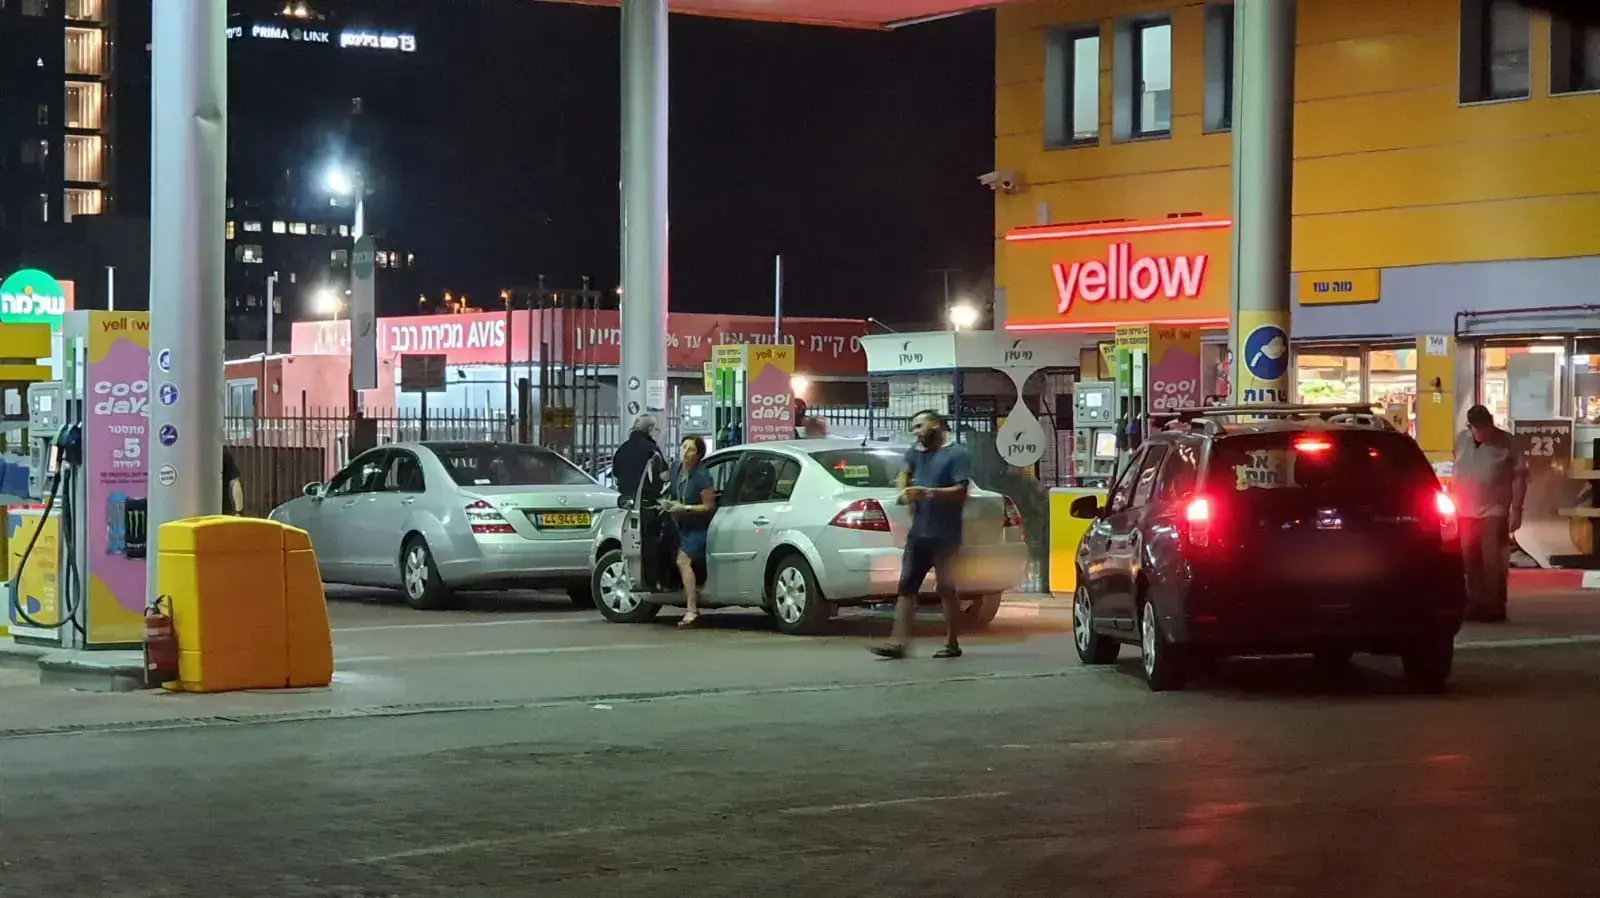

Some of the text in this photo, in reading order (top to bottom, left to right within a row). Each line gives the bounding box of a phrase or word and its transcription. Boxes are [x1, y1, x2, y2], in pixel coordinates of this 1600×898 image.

[252, 26, 329, 42] PRIMA LINK
[1053, 242, 1207, 314] yellow
[0, 292, 65, 315] שלמה
[391, 320, 505, 351] AVIS מכירת רכב
[899, 354, 912, 365] עדן
[1005, 351, 1021, 363] עדן
[94, 380, 148, 396] coo
[1153, 380, 1196, 394] cool
[752, 394, 791, 406] cool
[1153, 394, 1195, 409] days
[752, 406, 790, 420] days
[108, 425, 145, 434] מונסטר
[124, 438, 141, 458] 5
[1008, 444, 1024, 456] עדן
[1531, 436, 1553, 456] 23
